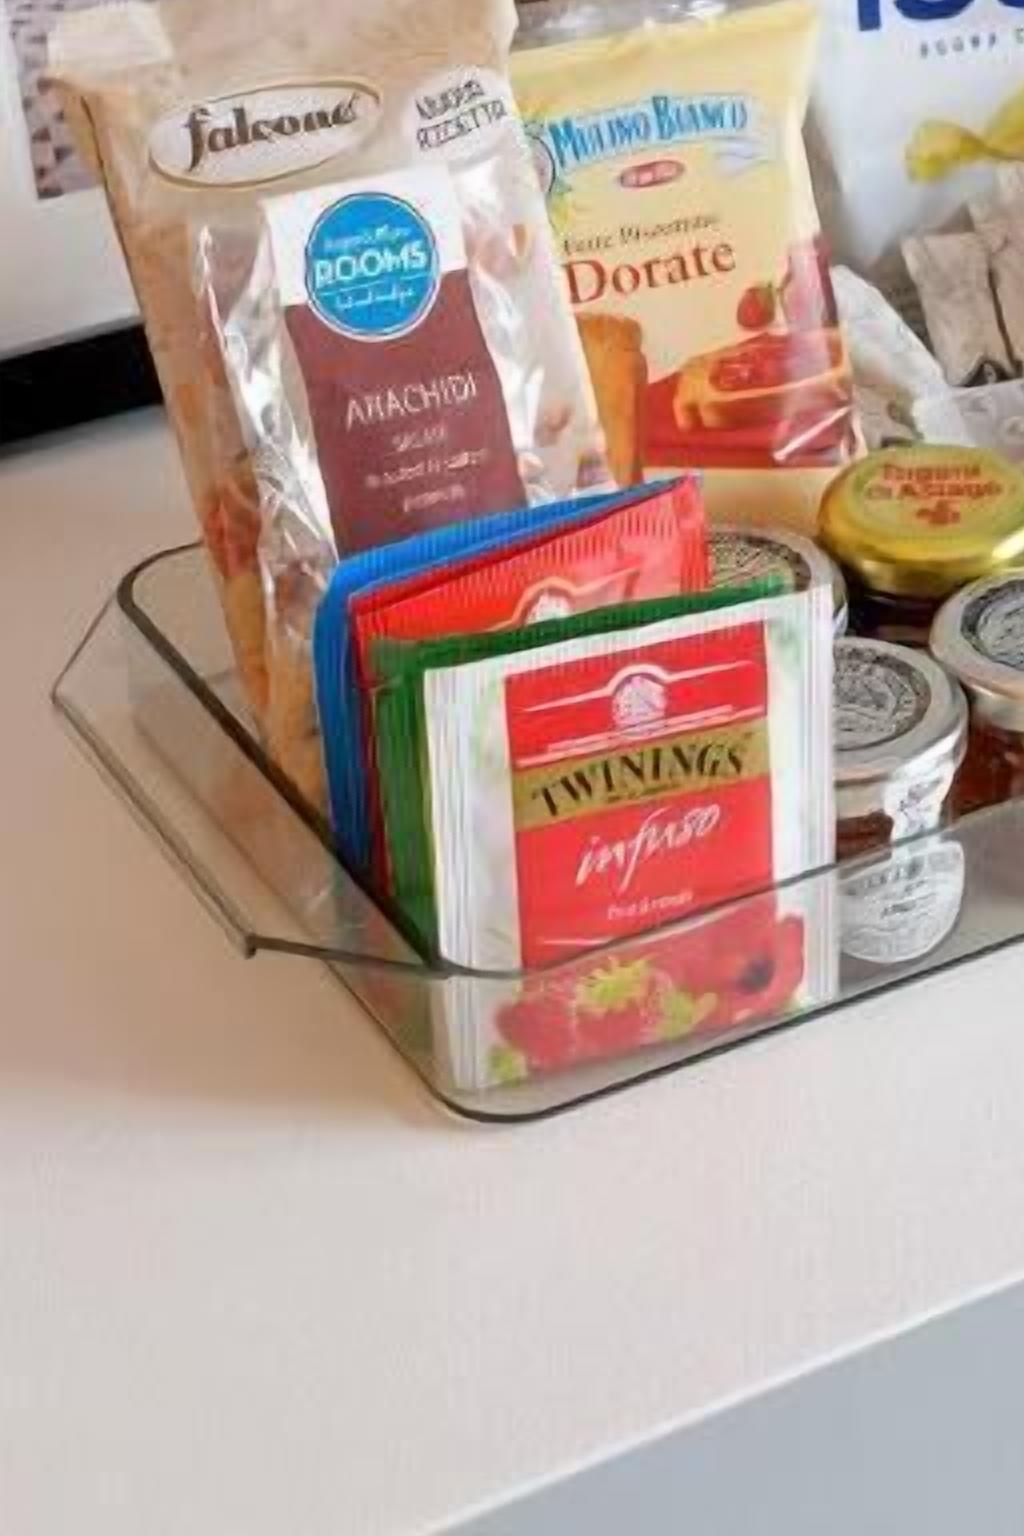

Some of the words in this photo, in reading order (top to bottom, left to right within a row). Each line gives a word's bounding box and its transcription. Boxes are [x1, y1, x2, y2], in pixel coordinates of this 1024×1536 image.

[182, 94, 362, 171] falcone
[313, 244, 427, 289] ROOMS
[562, 238, 737, 305] Dorate
[345, 373, 479, 430] ARACHIDI
[530, 733, 752, 817] TWININGS
[574, 803, 721, 898] infuso
